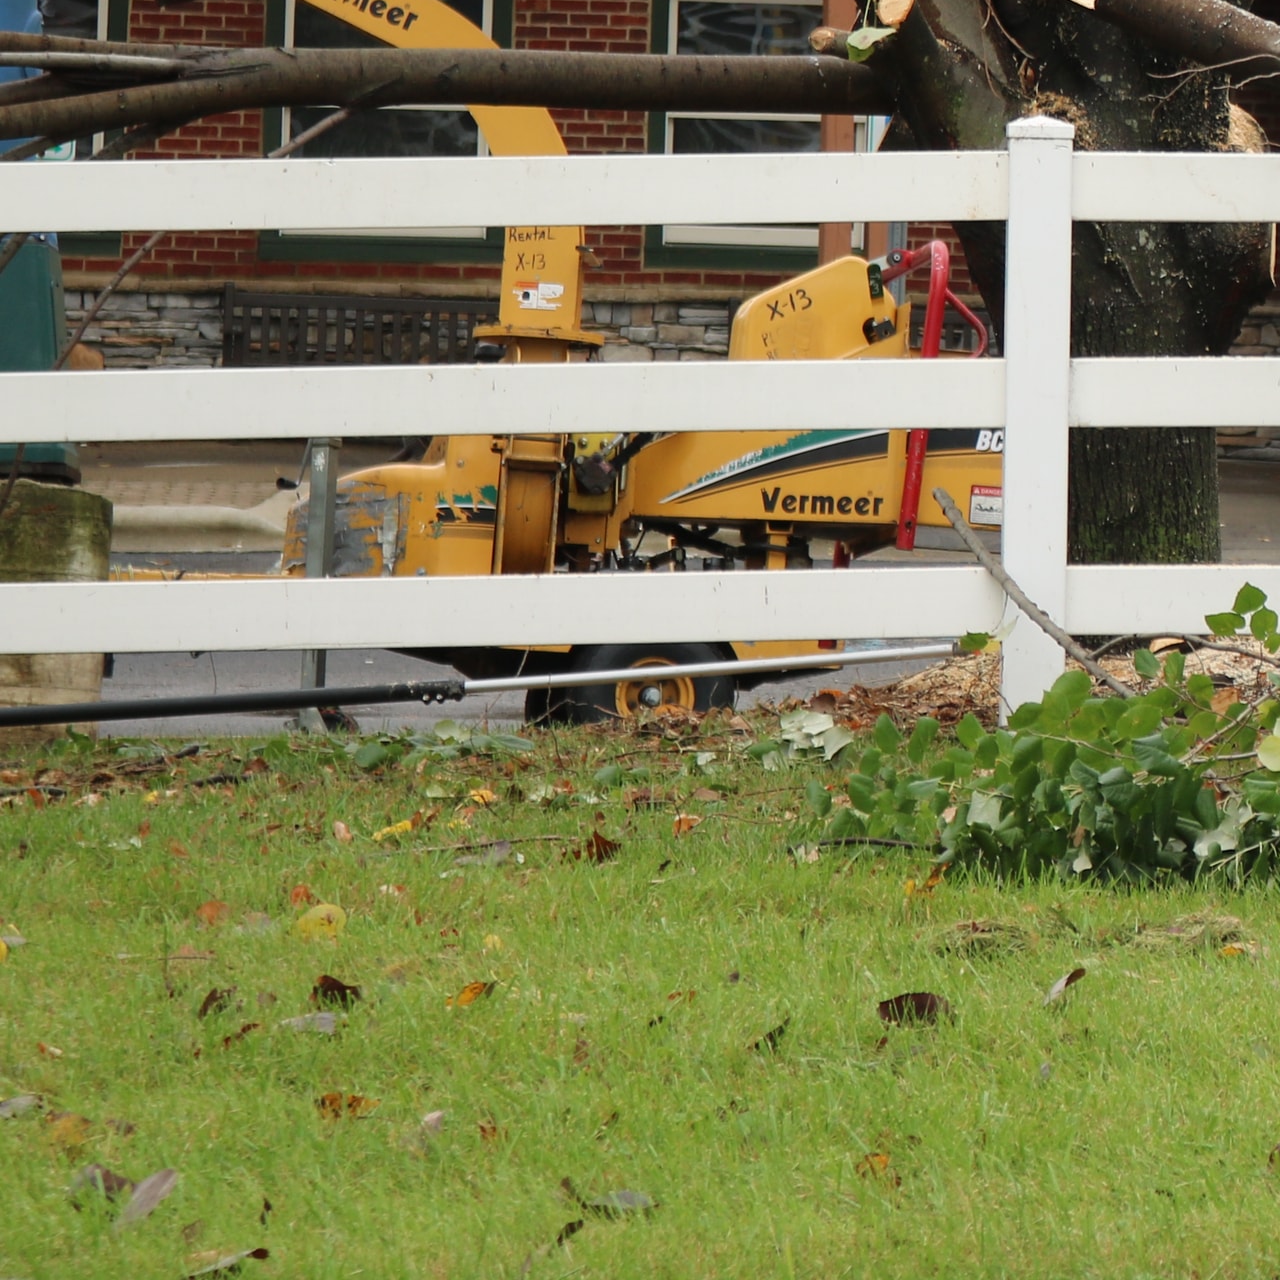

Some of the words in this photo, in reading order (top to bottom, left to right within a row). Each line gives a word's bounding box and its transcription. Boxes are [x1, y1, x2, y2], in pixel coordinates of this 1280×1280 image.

[515, 252, 546, 271] X-13
[766, 289, 813, 321] X-13
[760, 487, 884, 516] Vermeer
